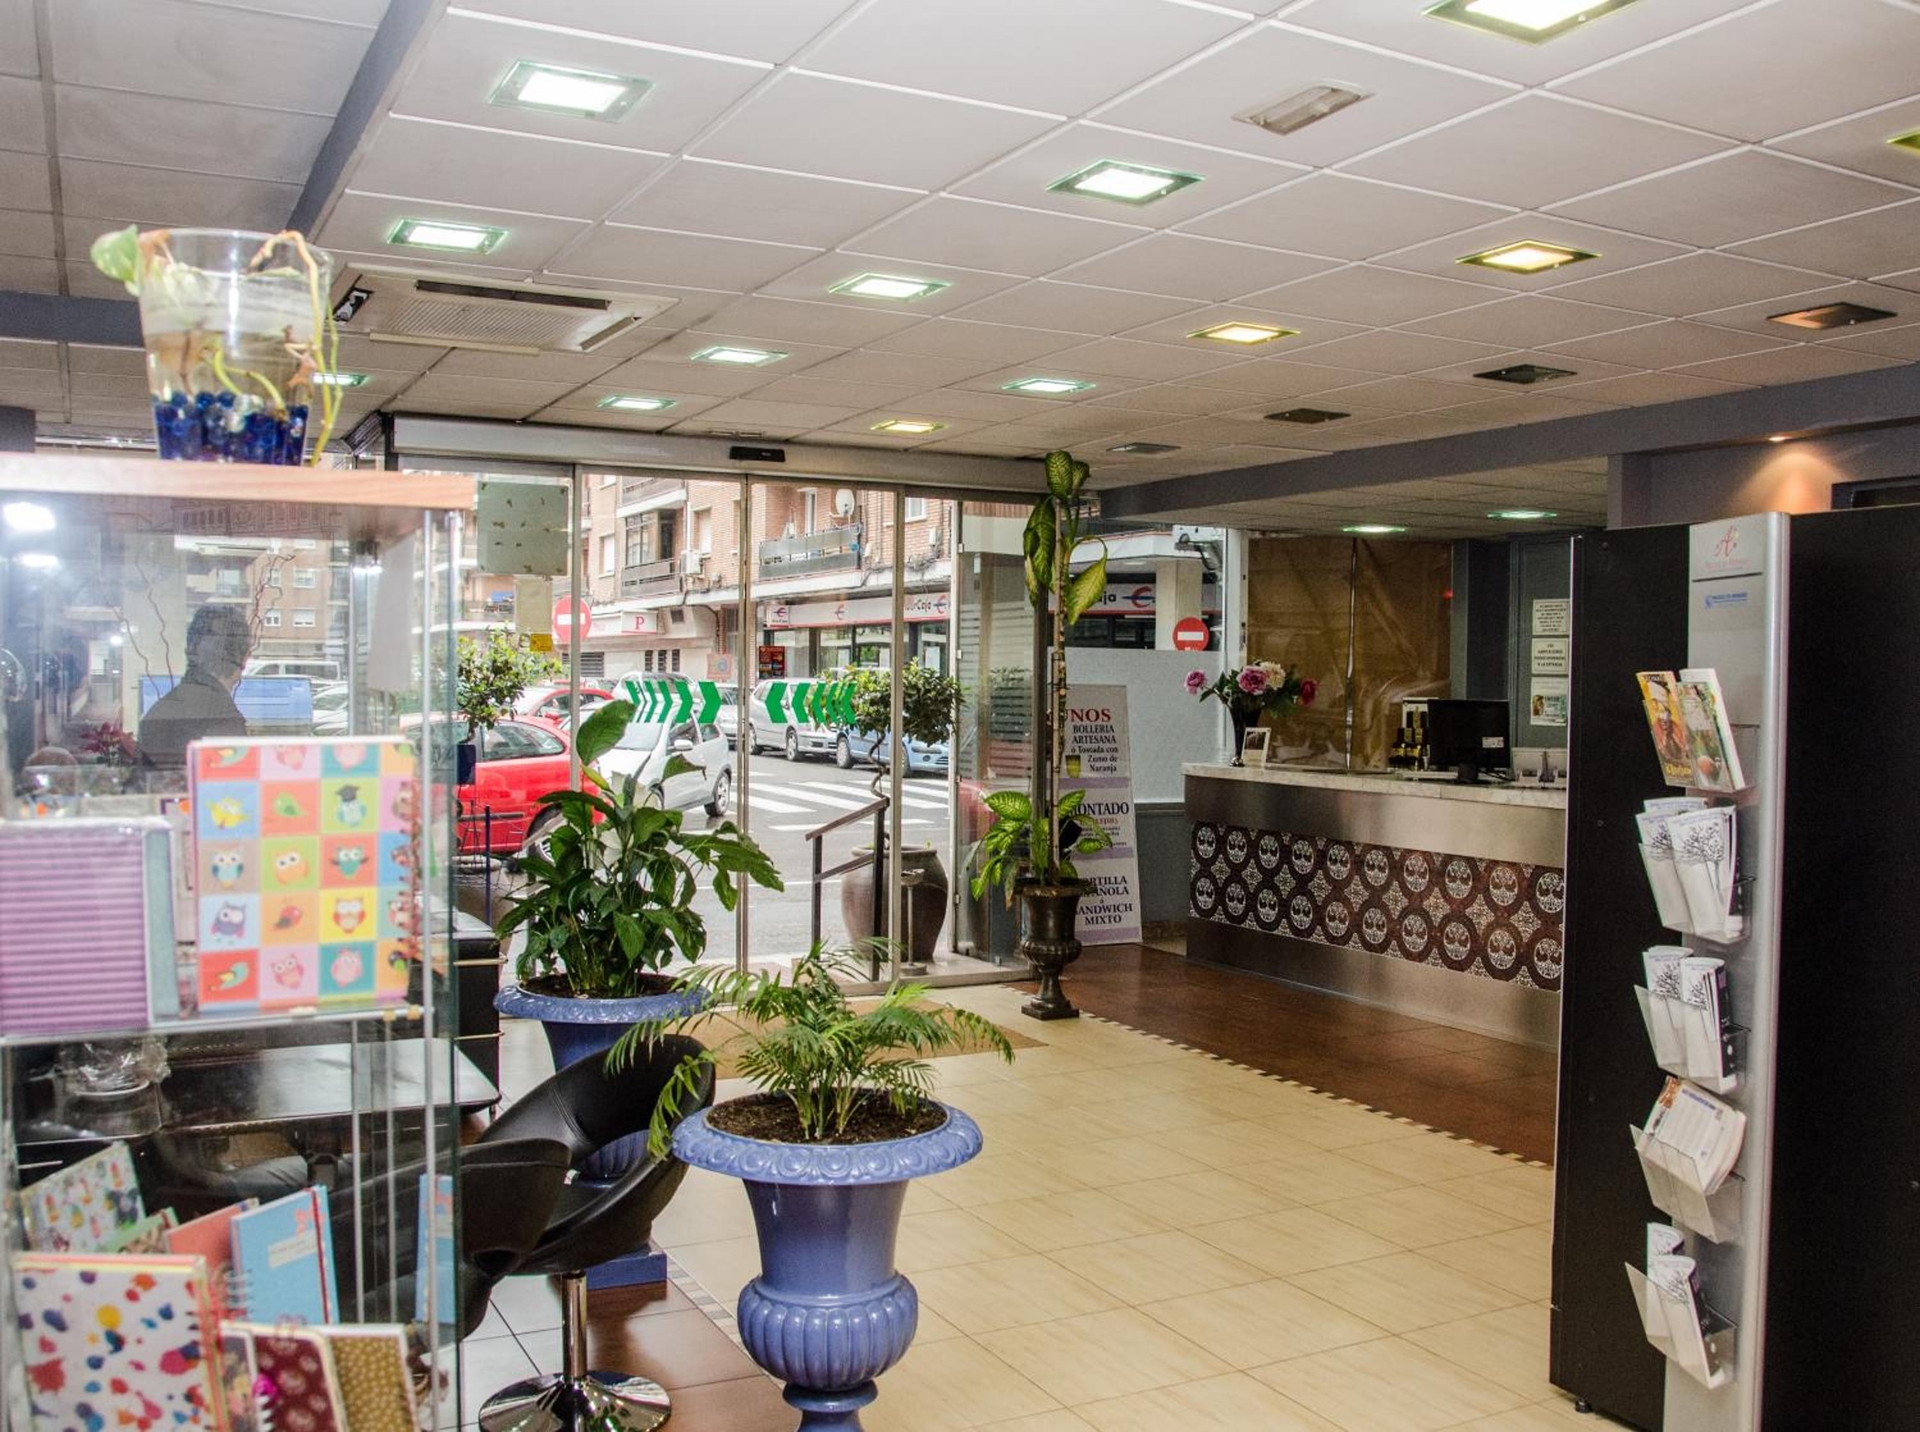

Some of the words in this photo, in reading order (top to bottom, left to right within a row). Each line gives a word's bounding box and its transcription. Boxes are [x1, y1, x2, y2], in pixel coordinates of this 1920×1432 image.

[635, 616, 645, 630] P
[1072, 735, 1117, 744] ARTESANA
[1087, 755, 1108, 763] Zumo
[1089, 764, 1117, 774] Naranja
[1084, 914, 1122, 925] MIXTO
